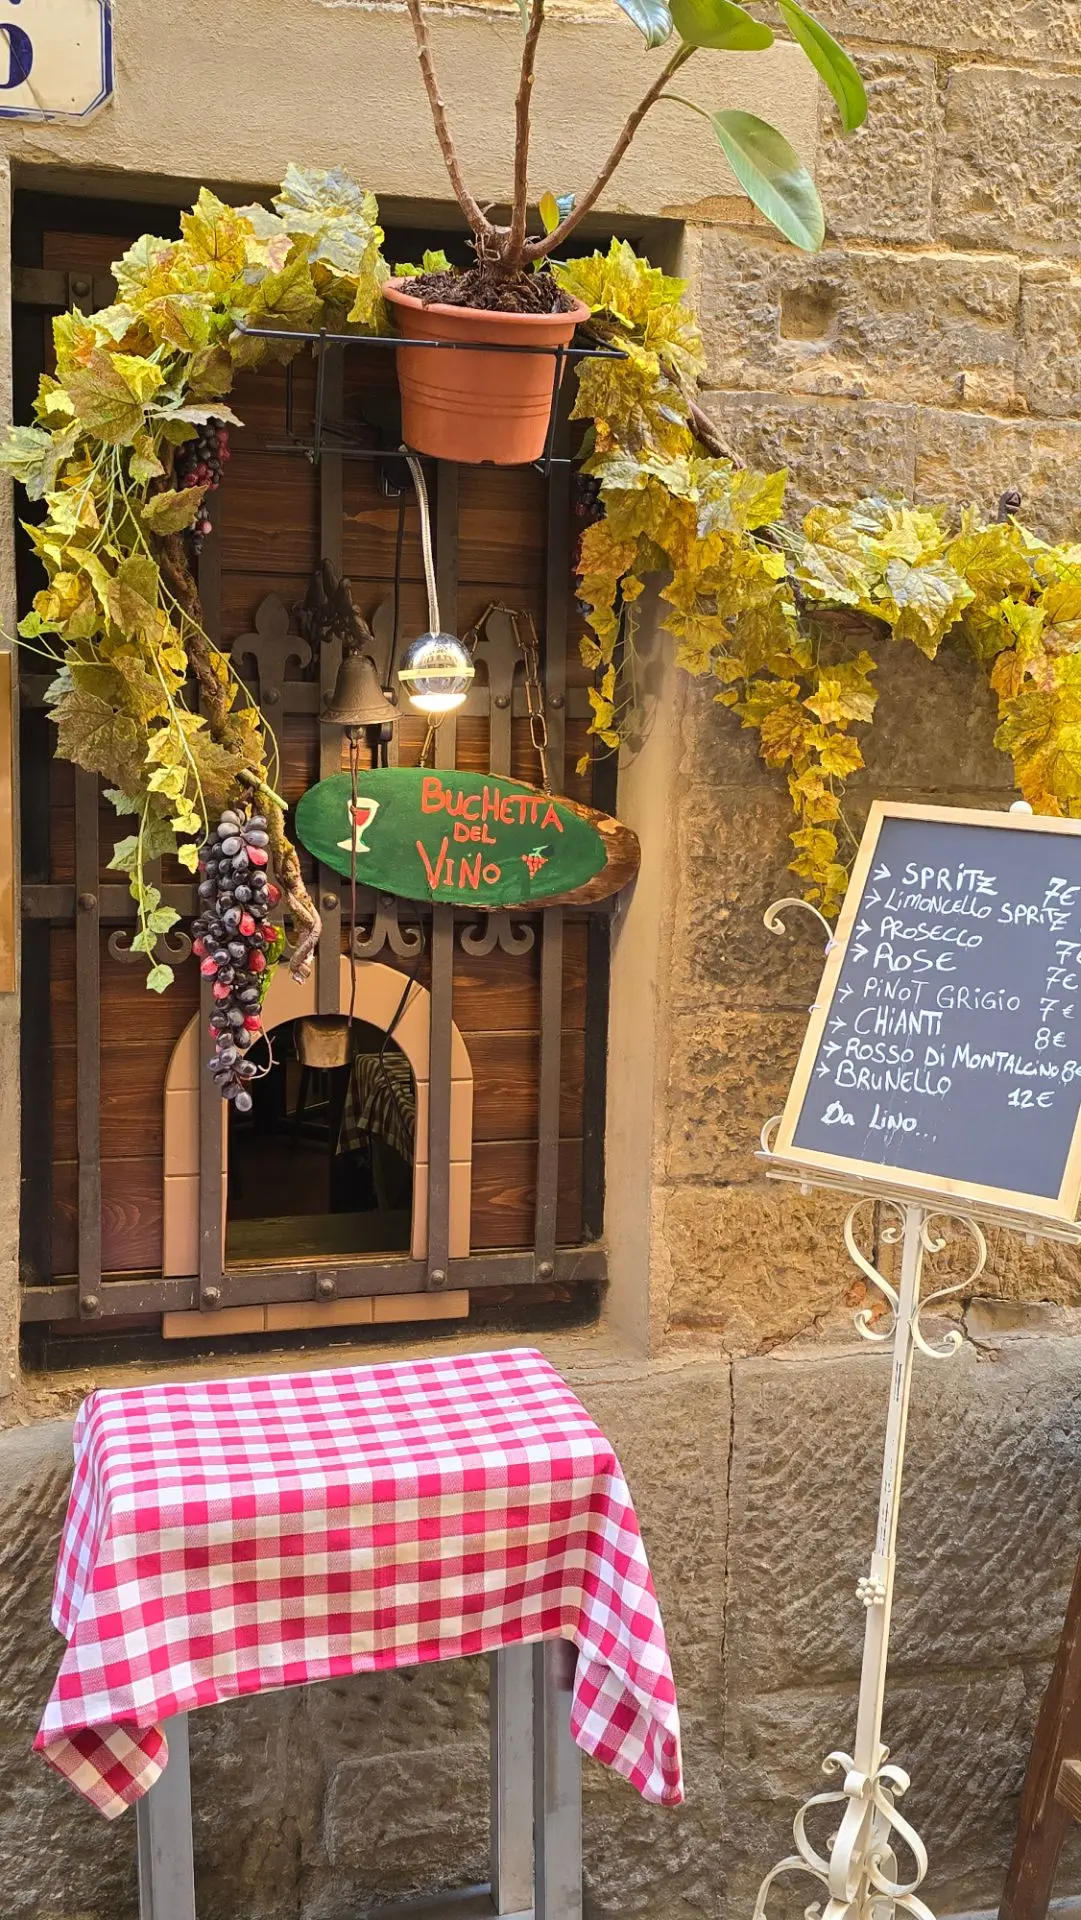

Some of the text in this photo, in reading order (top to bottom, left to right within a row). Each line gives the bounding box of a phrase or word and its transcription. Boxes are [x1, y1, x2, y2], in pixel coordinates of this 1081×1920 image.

[420, 777, 563, 833] BUCHETTA
[454, 822, 496, 844] DEL
[416, 837, 501, 890] VINO
[880, 916, 983, 948] PROSECCO
[845, 1037, 914, 1065] ROSSO
